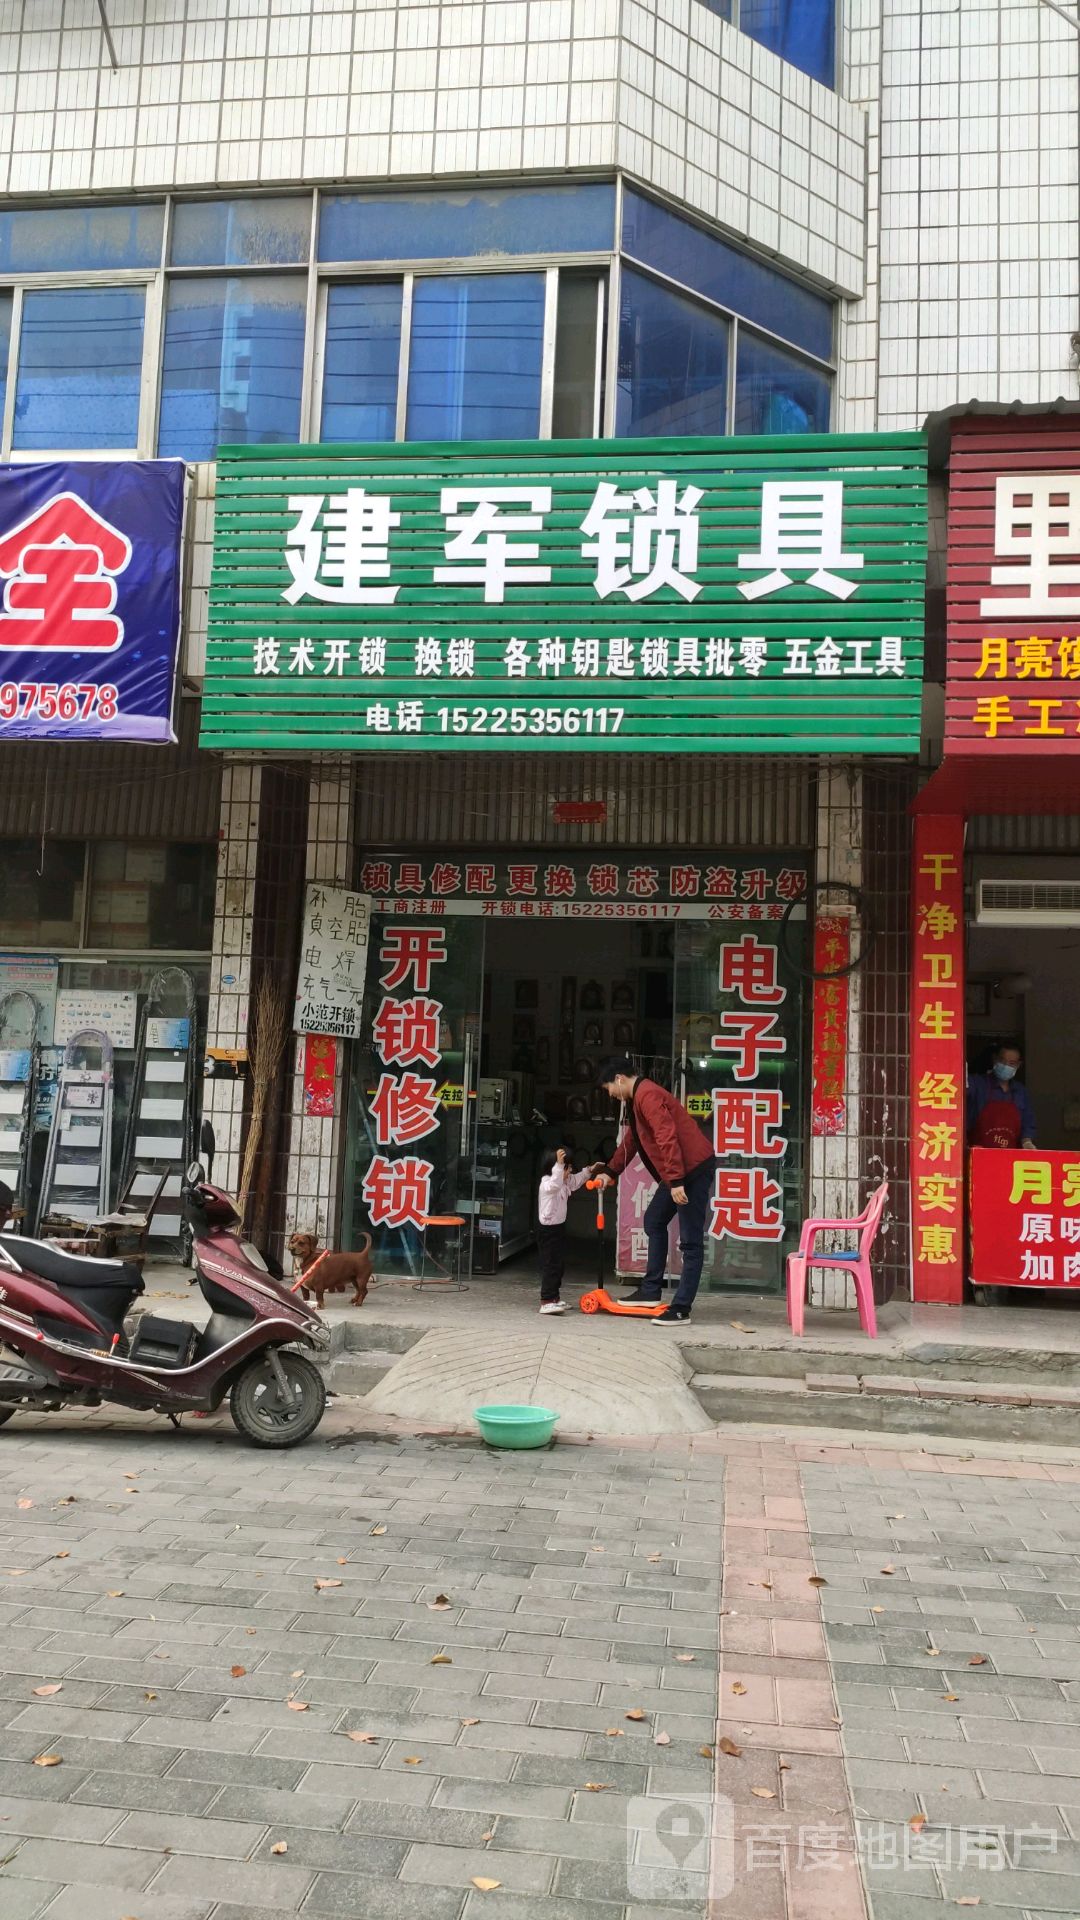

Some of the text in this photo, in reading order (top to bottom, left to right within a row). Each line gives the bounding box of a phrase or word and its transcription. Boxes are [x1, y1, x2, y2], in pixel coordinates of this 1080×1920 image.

[280, 480, 864, 605] 建军锁具
[0, 491, 132, 652] 全
[253, 635, 906, 678] 技术开锁 换锁 各种钥匙锁具批零 五金工具
[0, 682, 119, 721] 975678
[366, 701, 625, 734] 电话 15225356117
[973, 695, 1080, 738] 手工
[360, 861, 497, 894] 锁具修配
[670, 866, 808, 901] 防盗升级
[375, 899, 447, 916] 工商注册
[708, 904, 785, 920] 公安备案
[362, 926, 447, 1231] 开锁修锁
[918, 854, 958, 1265] 干净卫生 经济实惠
[441, 1089, 463, 1101] 左拉
[689, 1099, 712, 1111] 右拉
[708, 934, 788, 1242] 电子配匙
